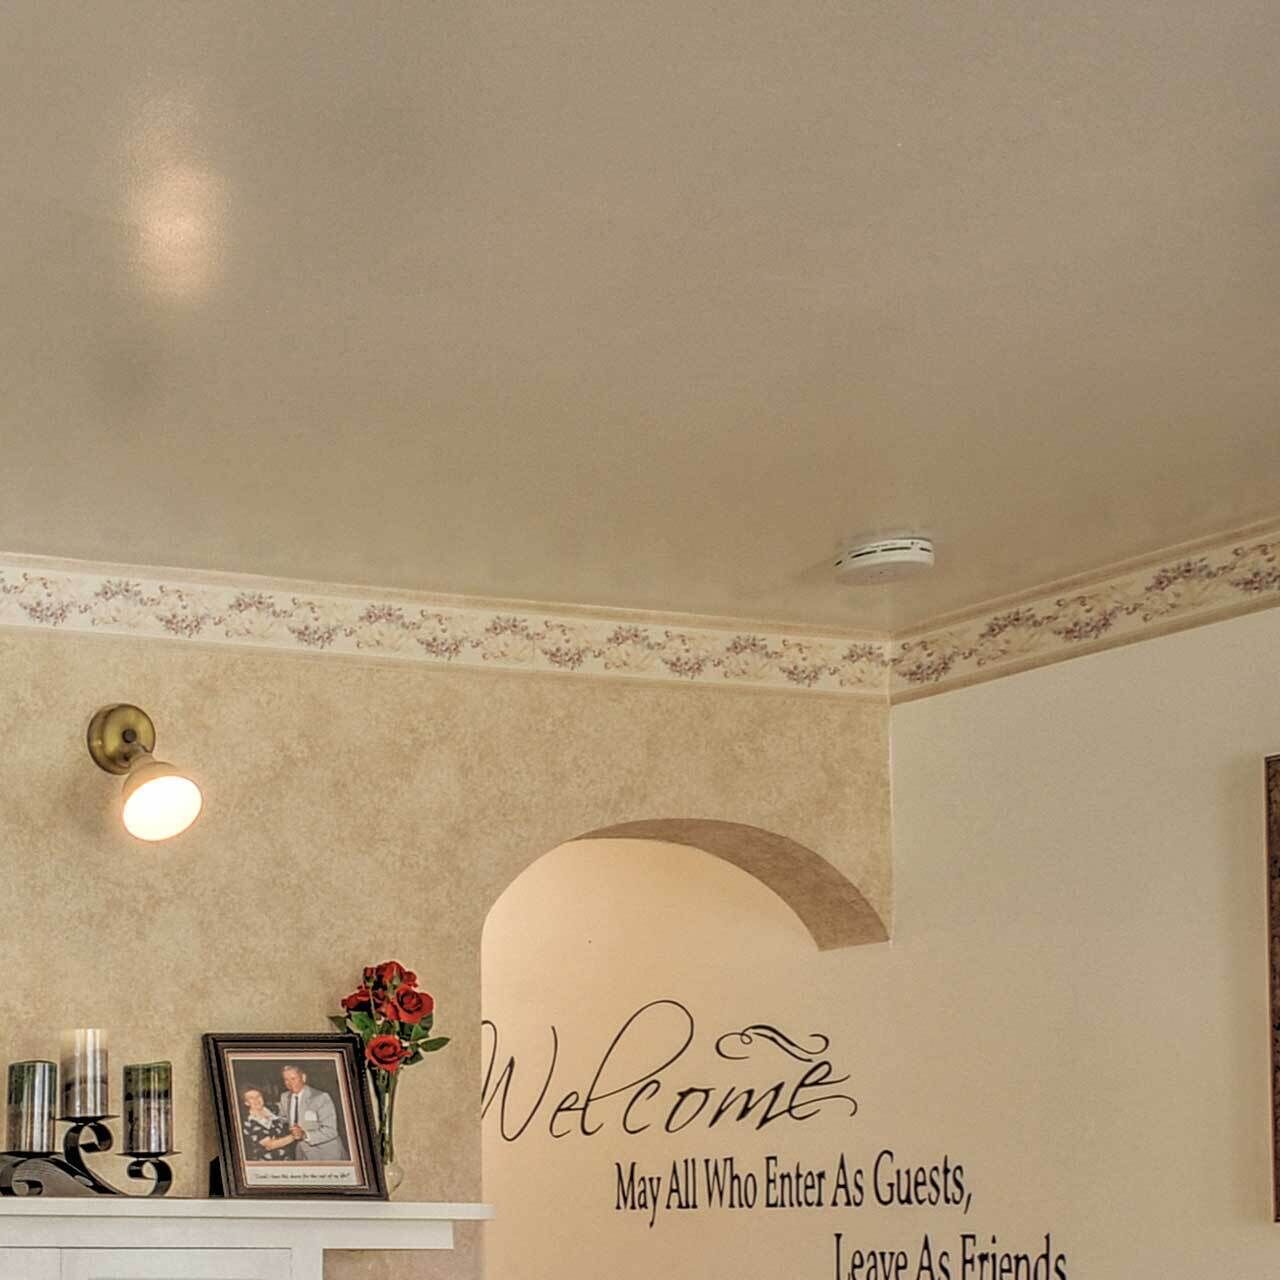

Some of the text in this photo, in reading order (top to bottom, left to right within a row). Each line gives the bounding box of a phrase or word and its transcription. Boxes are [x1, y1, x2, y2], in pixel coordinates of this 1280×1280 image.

[481, 999, 858, 1142] Welcome
[614, 1149, 973, 1229] May All Who Enter As Guests,
